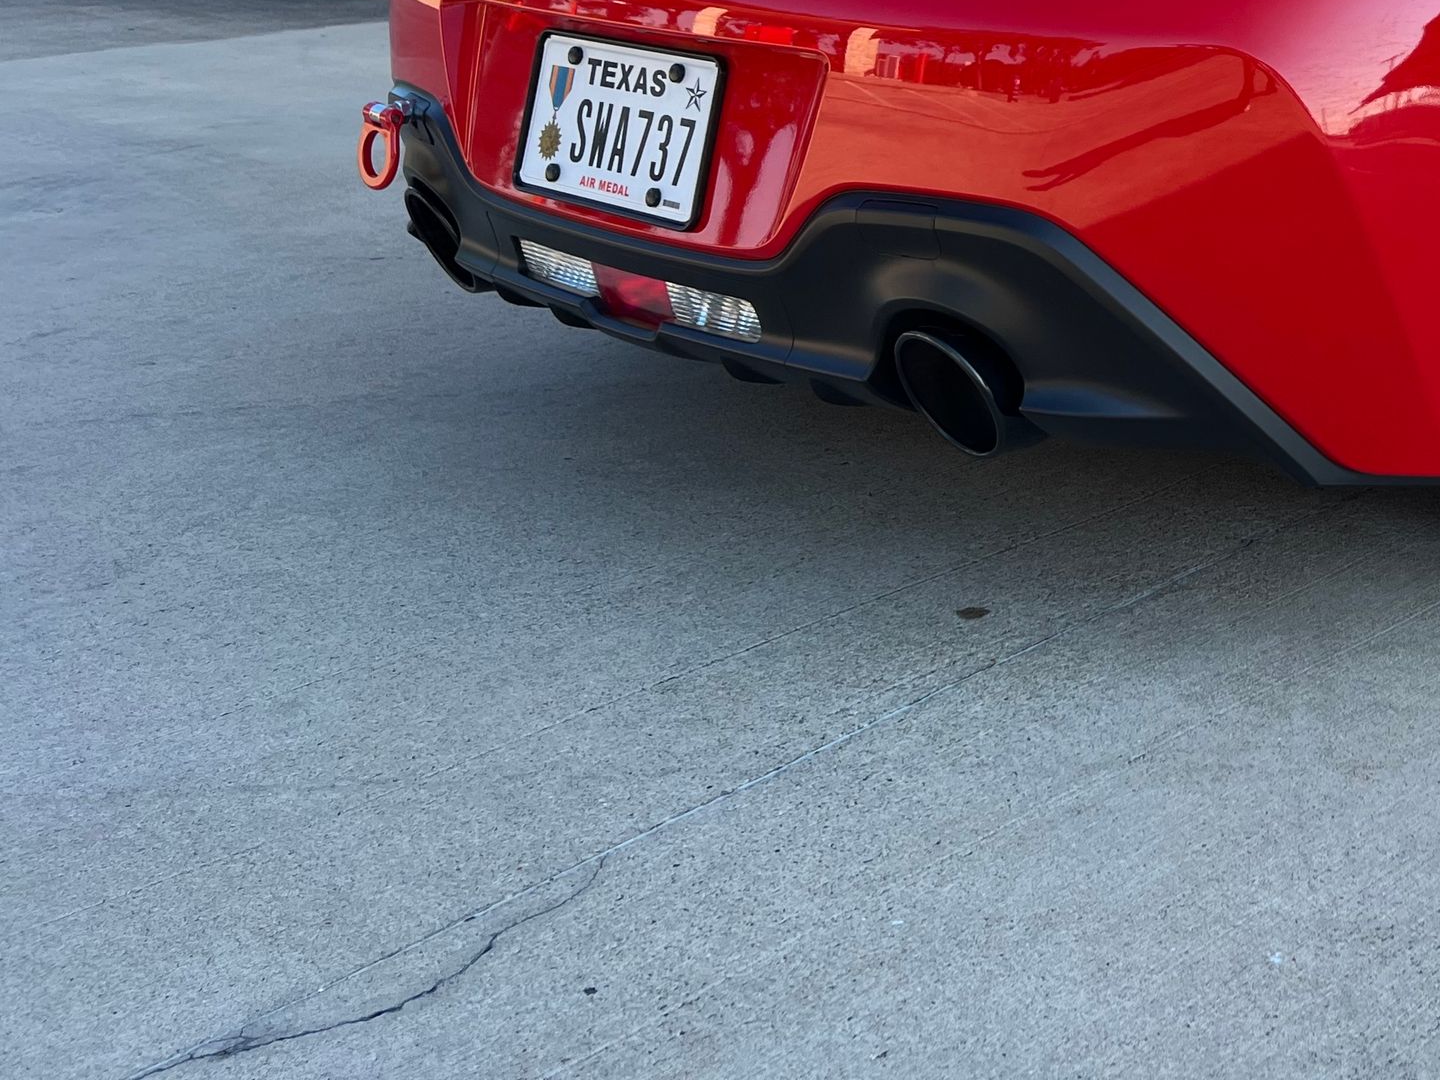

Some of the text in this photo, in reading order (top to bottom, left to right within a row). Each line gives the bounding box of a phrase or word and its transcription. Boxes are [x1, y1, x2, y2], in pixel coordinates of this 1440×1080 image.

[588, 58, 667, 98] TEXAS
[569, 98, 697, 187] SWA737
[579, 175, 630, 197] AIR MEDAL
